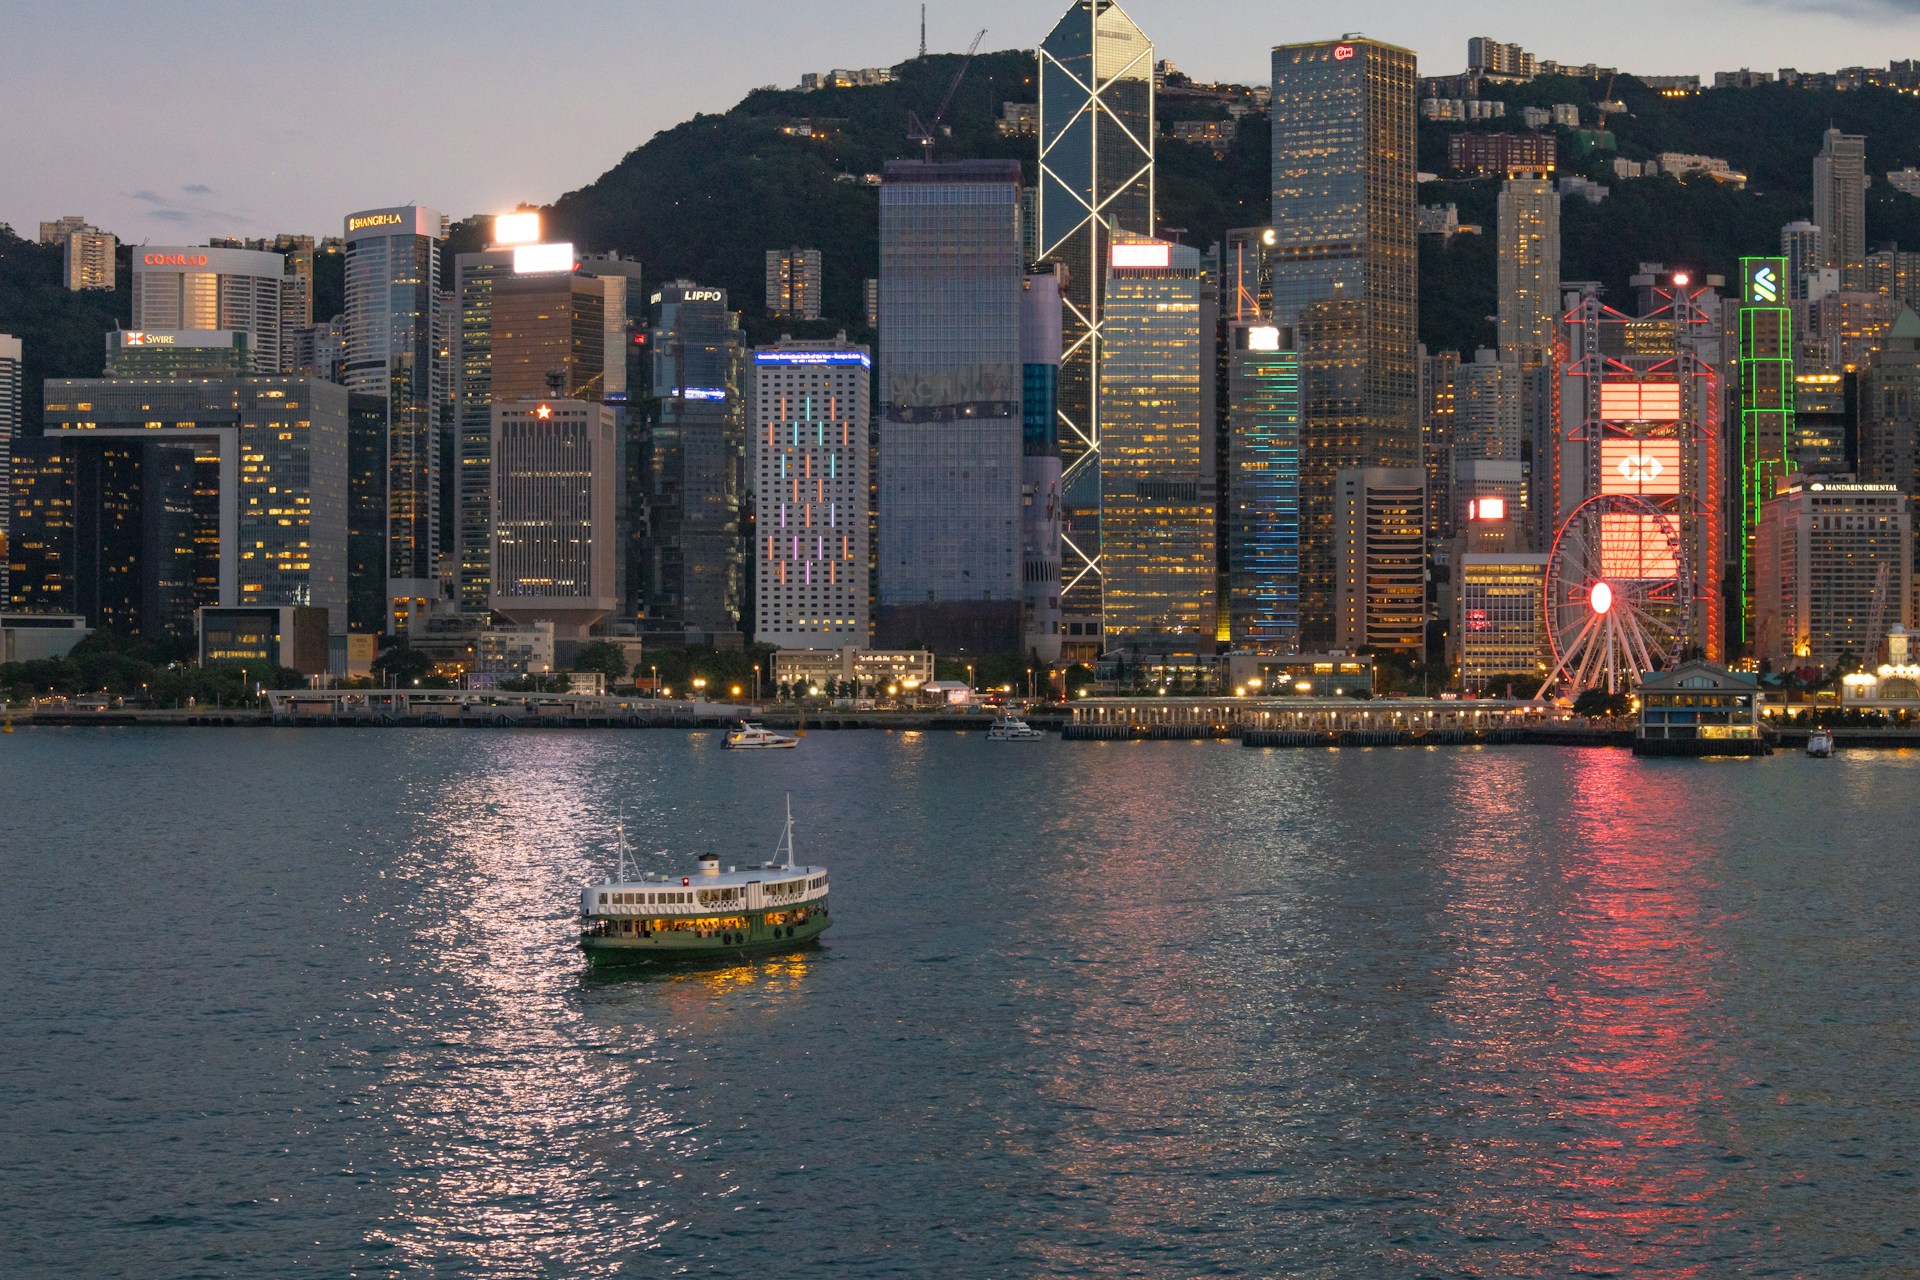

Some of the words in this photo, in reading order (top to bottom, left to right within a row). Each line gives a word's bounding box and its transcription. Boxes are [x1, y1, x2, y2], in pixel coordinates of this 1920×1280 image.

[354, 214, 402, 229] SHANGRI-LA
[144, 253, 208, 266] CONRAD
[684, 290, 722, 302] LIPPO
[1825, 484, 1863, 492] MANDARIN
[1863, 484, 1898, 492] ORIENTAL
